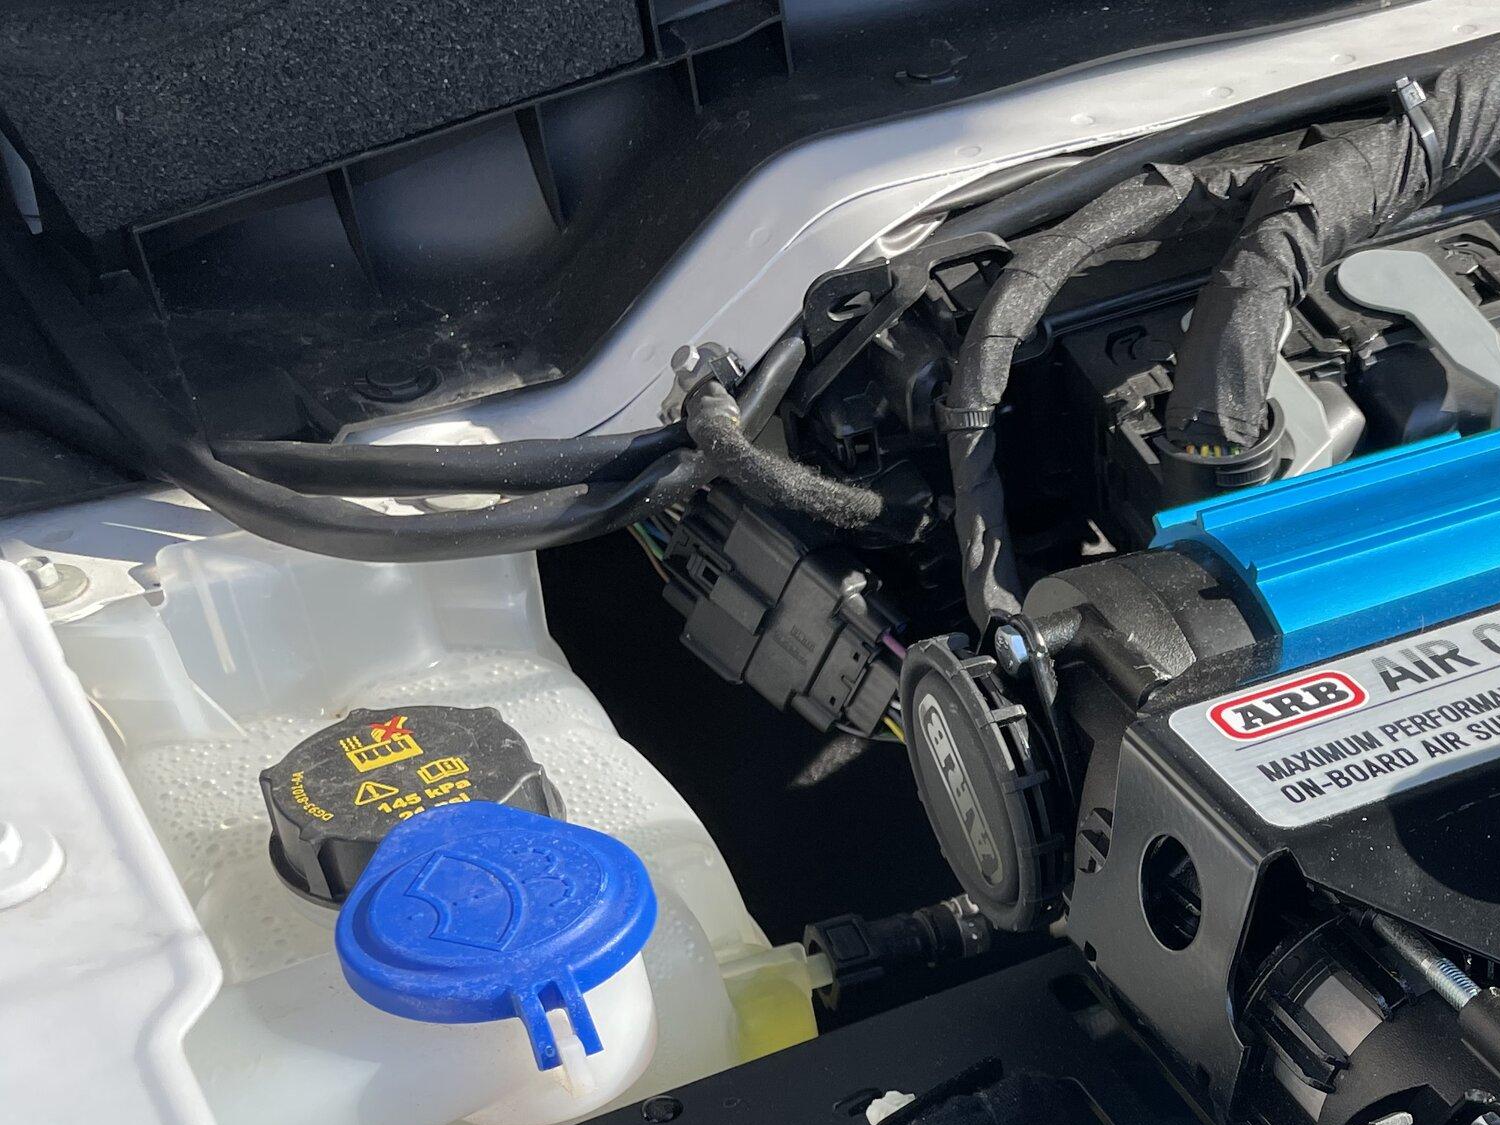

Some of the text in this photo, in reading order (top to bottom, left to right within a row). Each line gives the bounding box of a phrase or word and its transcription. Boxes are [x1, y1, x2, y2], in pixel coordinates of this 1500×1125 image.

[1232, 681, 1350, 731] ARB
[1370, 639, 1479, 692] AIR
[1256, 731, 1383, 783] MAXIMUM
[1280, 747, 1419, 803] ON-BOARD
[1421, 731, 1470, 759] AIR
[377, 792, 422, 814] 145
[424, 779, 472, 799] kPa
